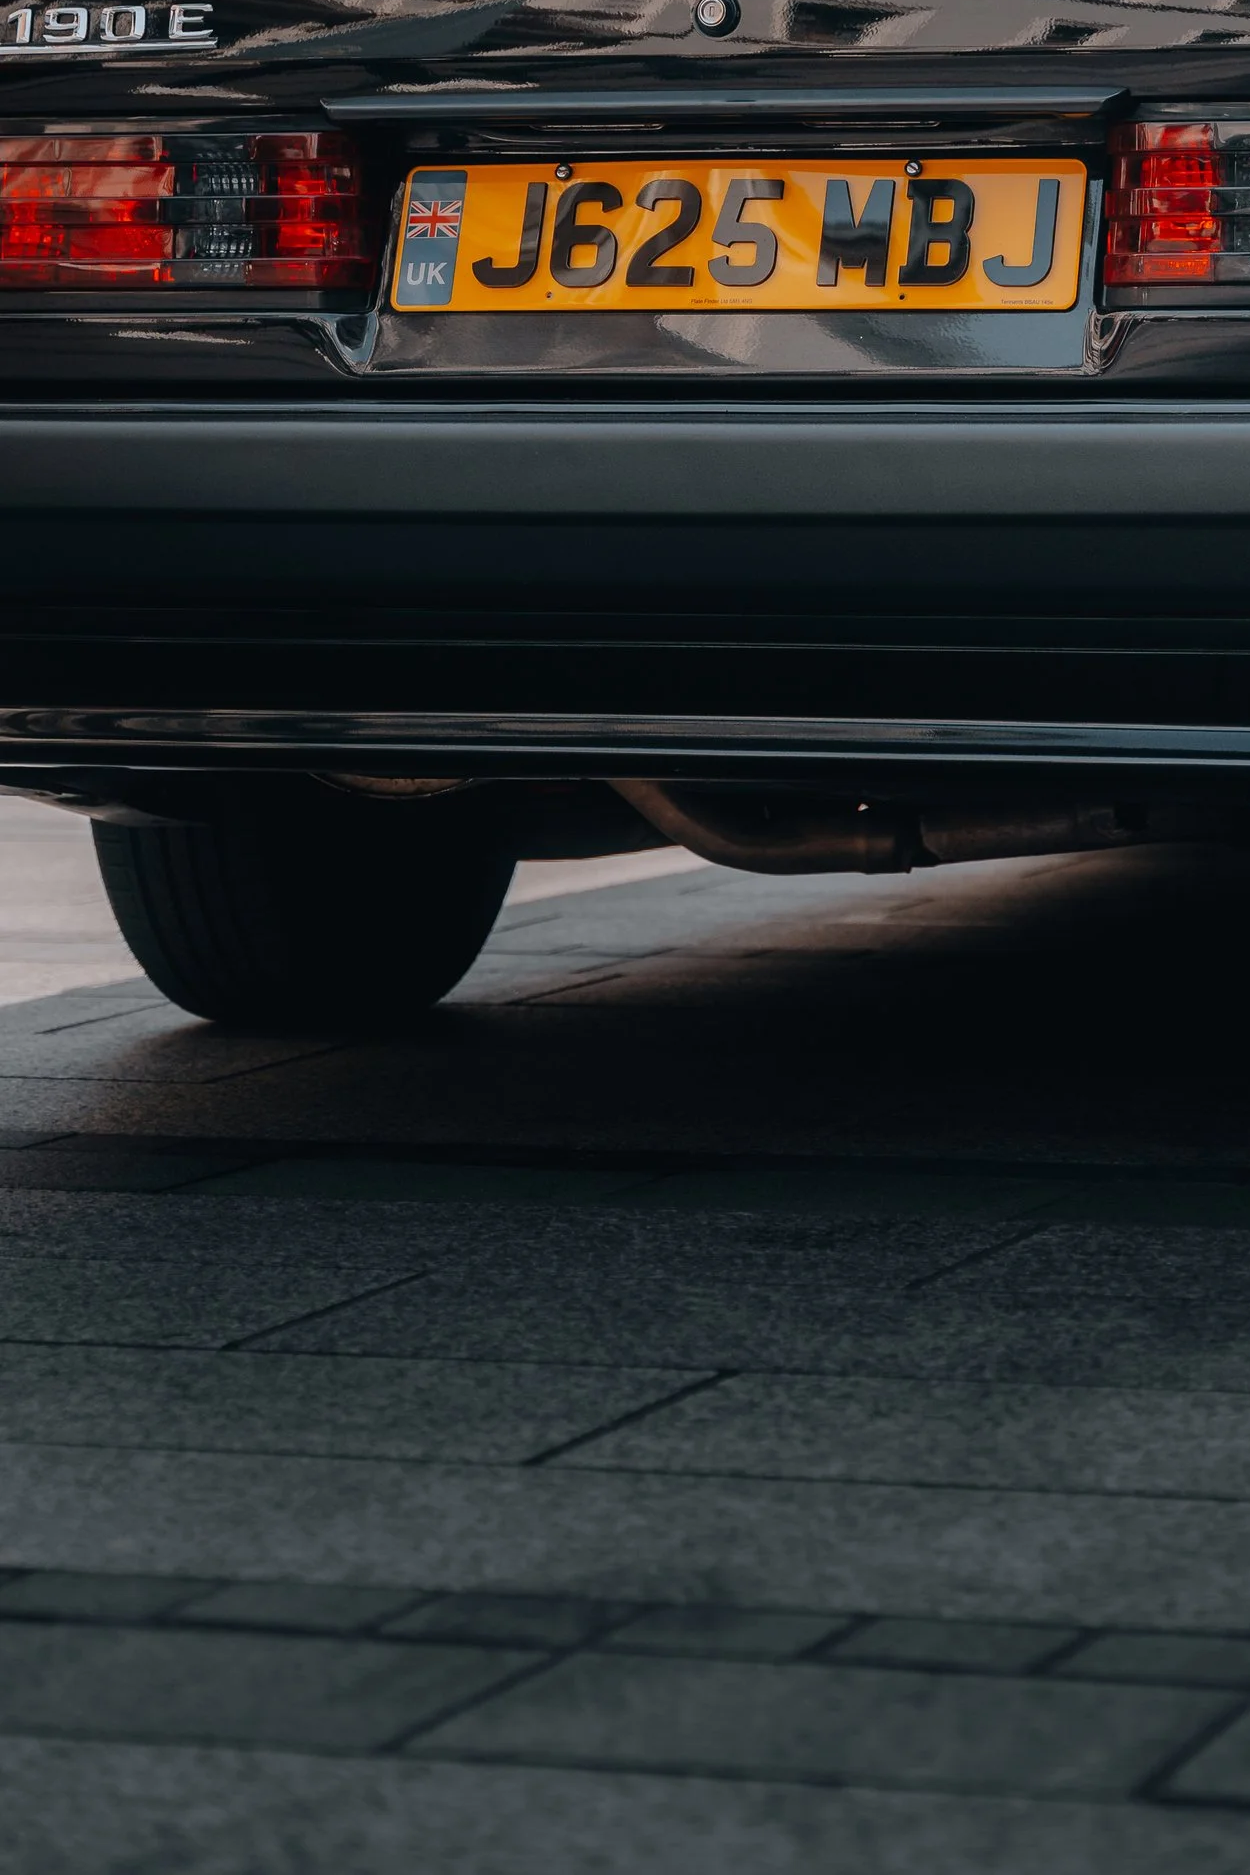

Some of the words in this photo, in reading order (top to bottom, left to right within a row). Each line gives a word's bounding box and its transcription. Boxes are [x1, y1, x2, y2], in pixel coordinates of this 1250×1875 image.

[472, 178, 785, 289] J625
[816, 178, 1061, 287] MBJ
[406, 262, 447, 286] UK
